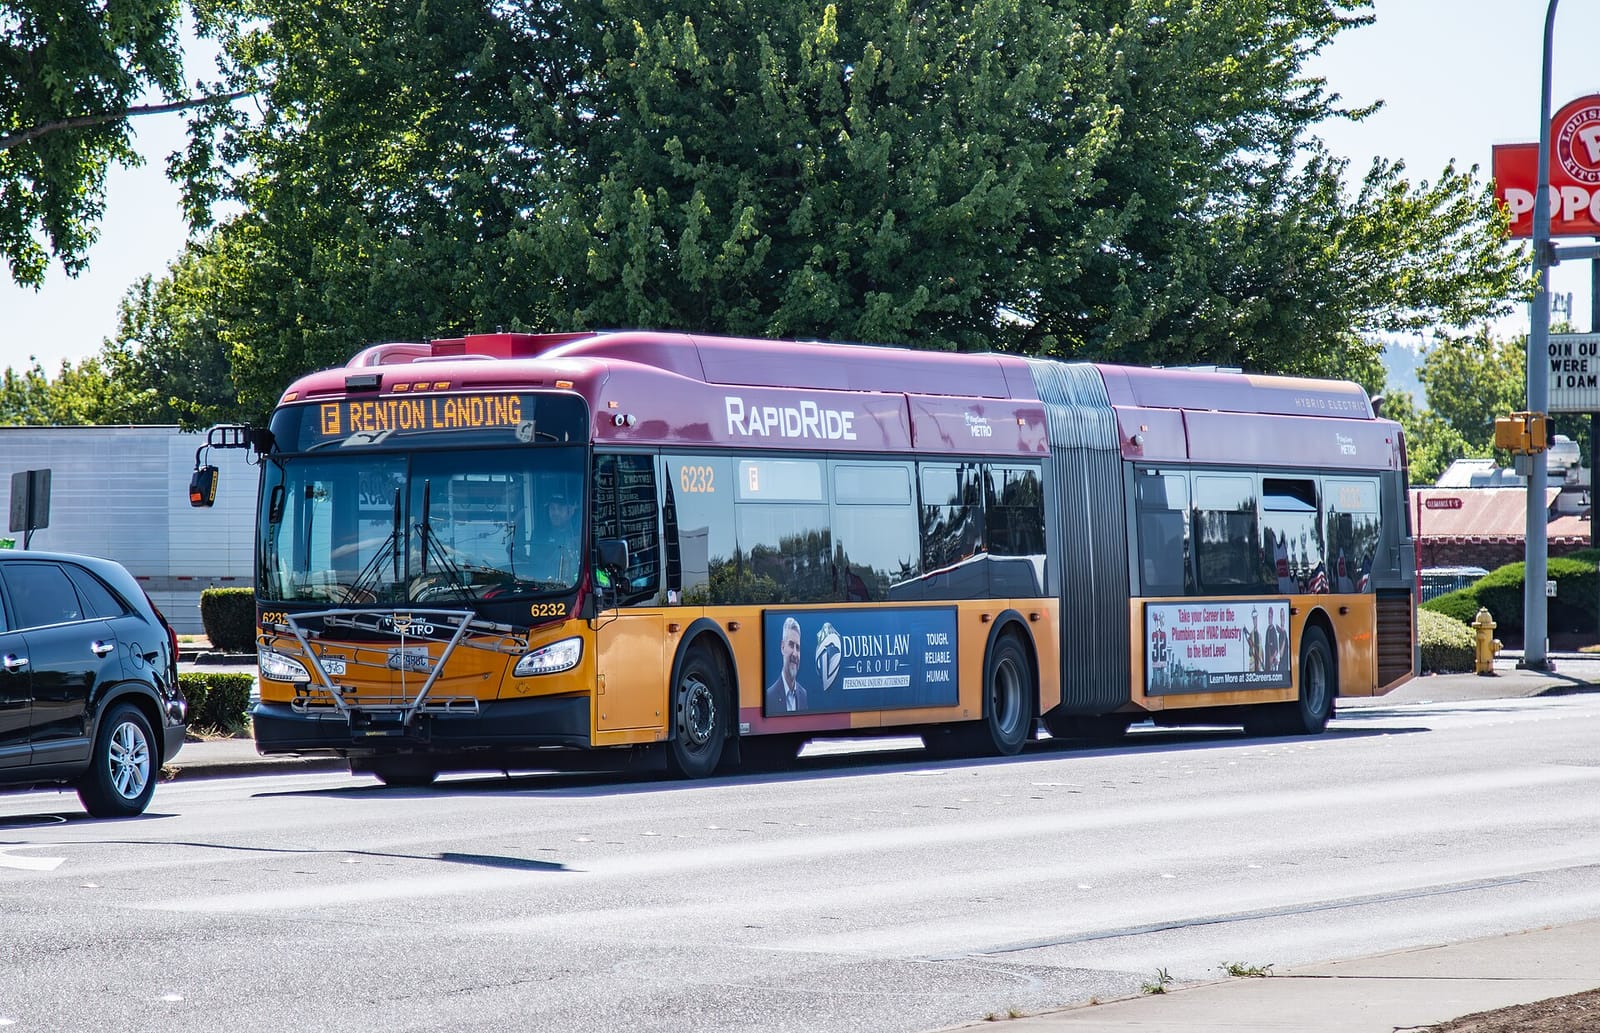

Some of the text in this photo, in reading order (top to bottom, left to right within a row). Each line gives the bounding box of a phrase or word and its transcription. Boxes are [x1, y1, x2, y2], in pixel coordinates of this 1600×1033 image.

[1561, 109, 1600, 142] LOUIS
[1563, 158, 1600, 181] KITC
[1551, 359, 1588, 372] WERE
[1295, 398, 1366, 411] HYBRID ELECTRIC
[321, 396, 521, 435] F RENTON LANDING
[681, 466, 715, 493] 6232
[531, 602, 566, 617] 6232
[1178, 609, 1190, 623] Take
[1191, 611, 1202, 625] your
[1202, 608, 1219, 623] Career
[1226, 608, 1235, 622] the
[926, 633, 949, 646] TOUGH.
[1172, 625, 1242, 643] Plumbing and HVAC Industry
[843, 633, 910, 658] DUBIN LAW
[1152, 631, 1167, 662] 32
[1201, 645, 1213, 657] Next
[1213, 644, 1227, 657] Level
[925, 652, 951, 664] RELIABLE.
[856, 659, 900, 673] GROUP
[845, 678, 867, 688] PERSONAL
[926, 670, 949, 682] HUMAN.
[1209, 673, 1283, 684] Learn More at 32Careers.com
